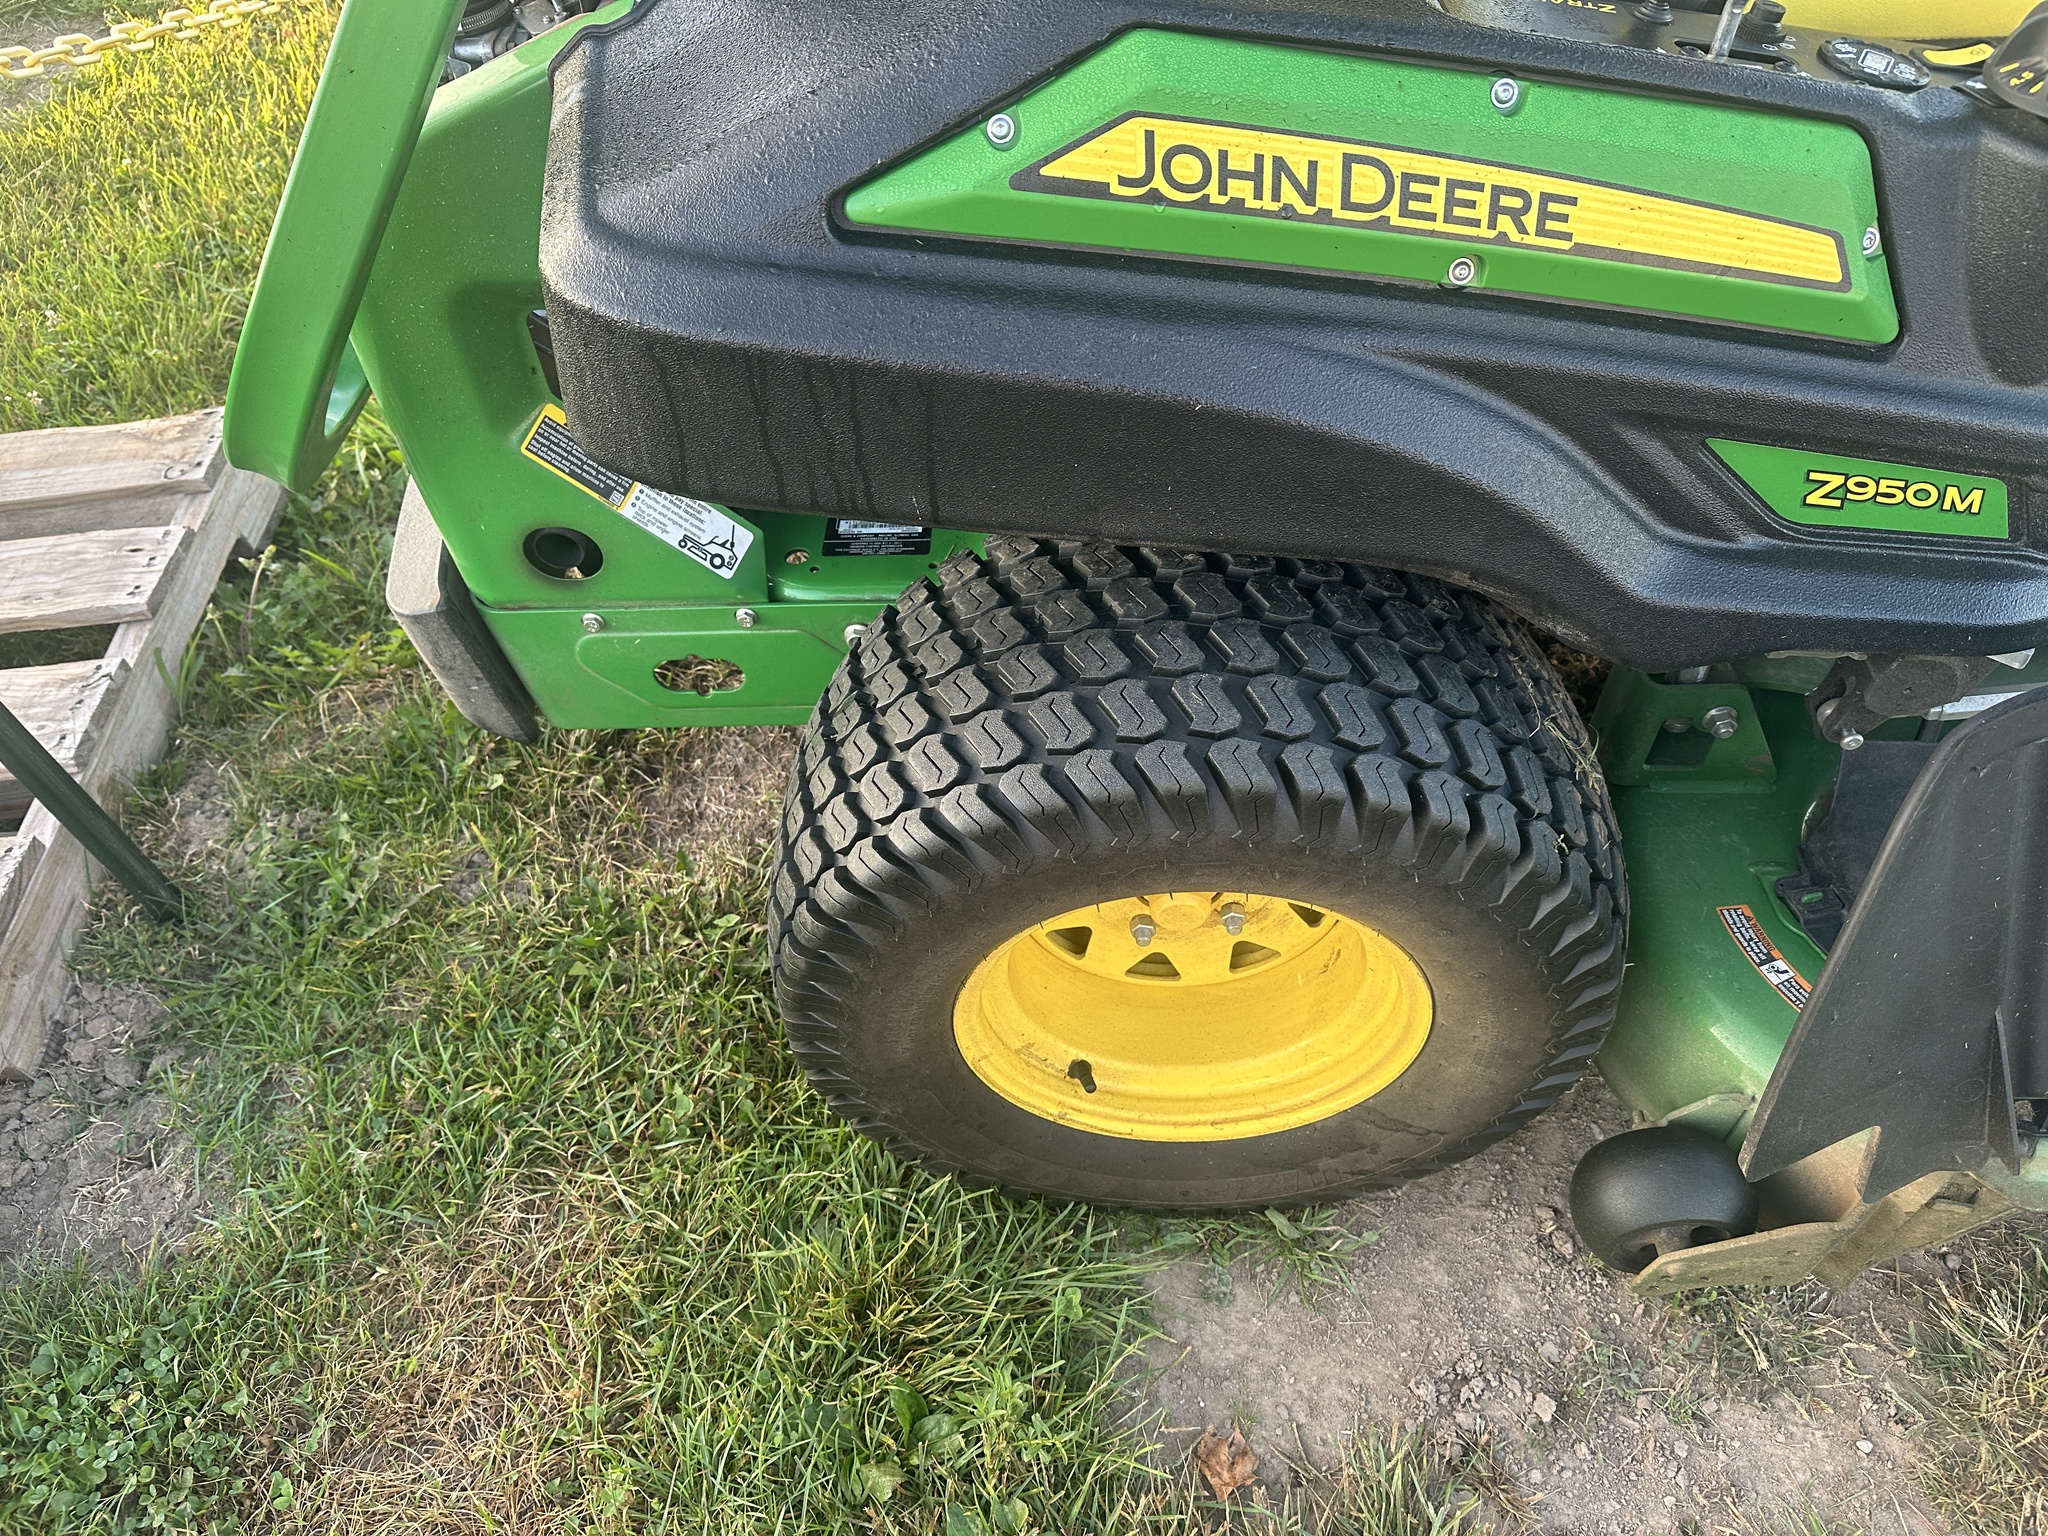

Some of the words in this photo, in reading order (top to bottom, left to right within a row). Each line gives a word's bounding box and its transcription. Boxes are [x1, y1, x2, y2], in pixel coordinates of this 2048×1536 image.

[1117, 129, 1318, 208] JOHN
[1341, 152, 1579, 242] DEERE
[550, 443, 567, 456] machine
[582, 472, 599, 484] machine
[587, 458, 597, 468] parts
[606, 470, 618, 480] cause
[1803, 469, 1986, 515] Z950M
[669, 498, 682, 510] these
[685, 502, 703, 515] special
[698, 502, 712, 514] entire
[638, 506, 646, 515] Top
[652, 516, 668, 528] mower
[641, 499, 658, 512] Engine
[658, 510, 668, 519] and
[668, 516, 683, 528] engine
[683, 526, 702, 540] screens
[646, 518, 656, 526] and
[662, 502, 671, 511] and
[671, 510, 689, 523] exhaust
[689, 520, 706, 534] system
[1730, 909, 1743, 927] rotating
[1749, 941, 1760, 953] keep
[1730, 924, 1740, 932] and
[1735, 933, 1748, 947] guards
[1739, 915, 1751, 928] avoid
[1747, 928, 1760, 942] injury
[1757, 941, 1768, 954] from
[1751, 922, 1775, 951] WARNING
[1789, 978, 1800, 989] Para
